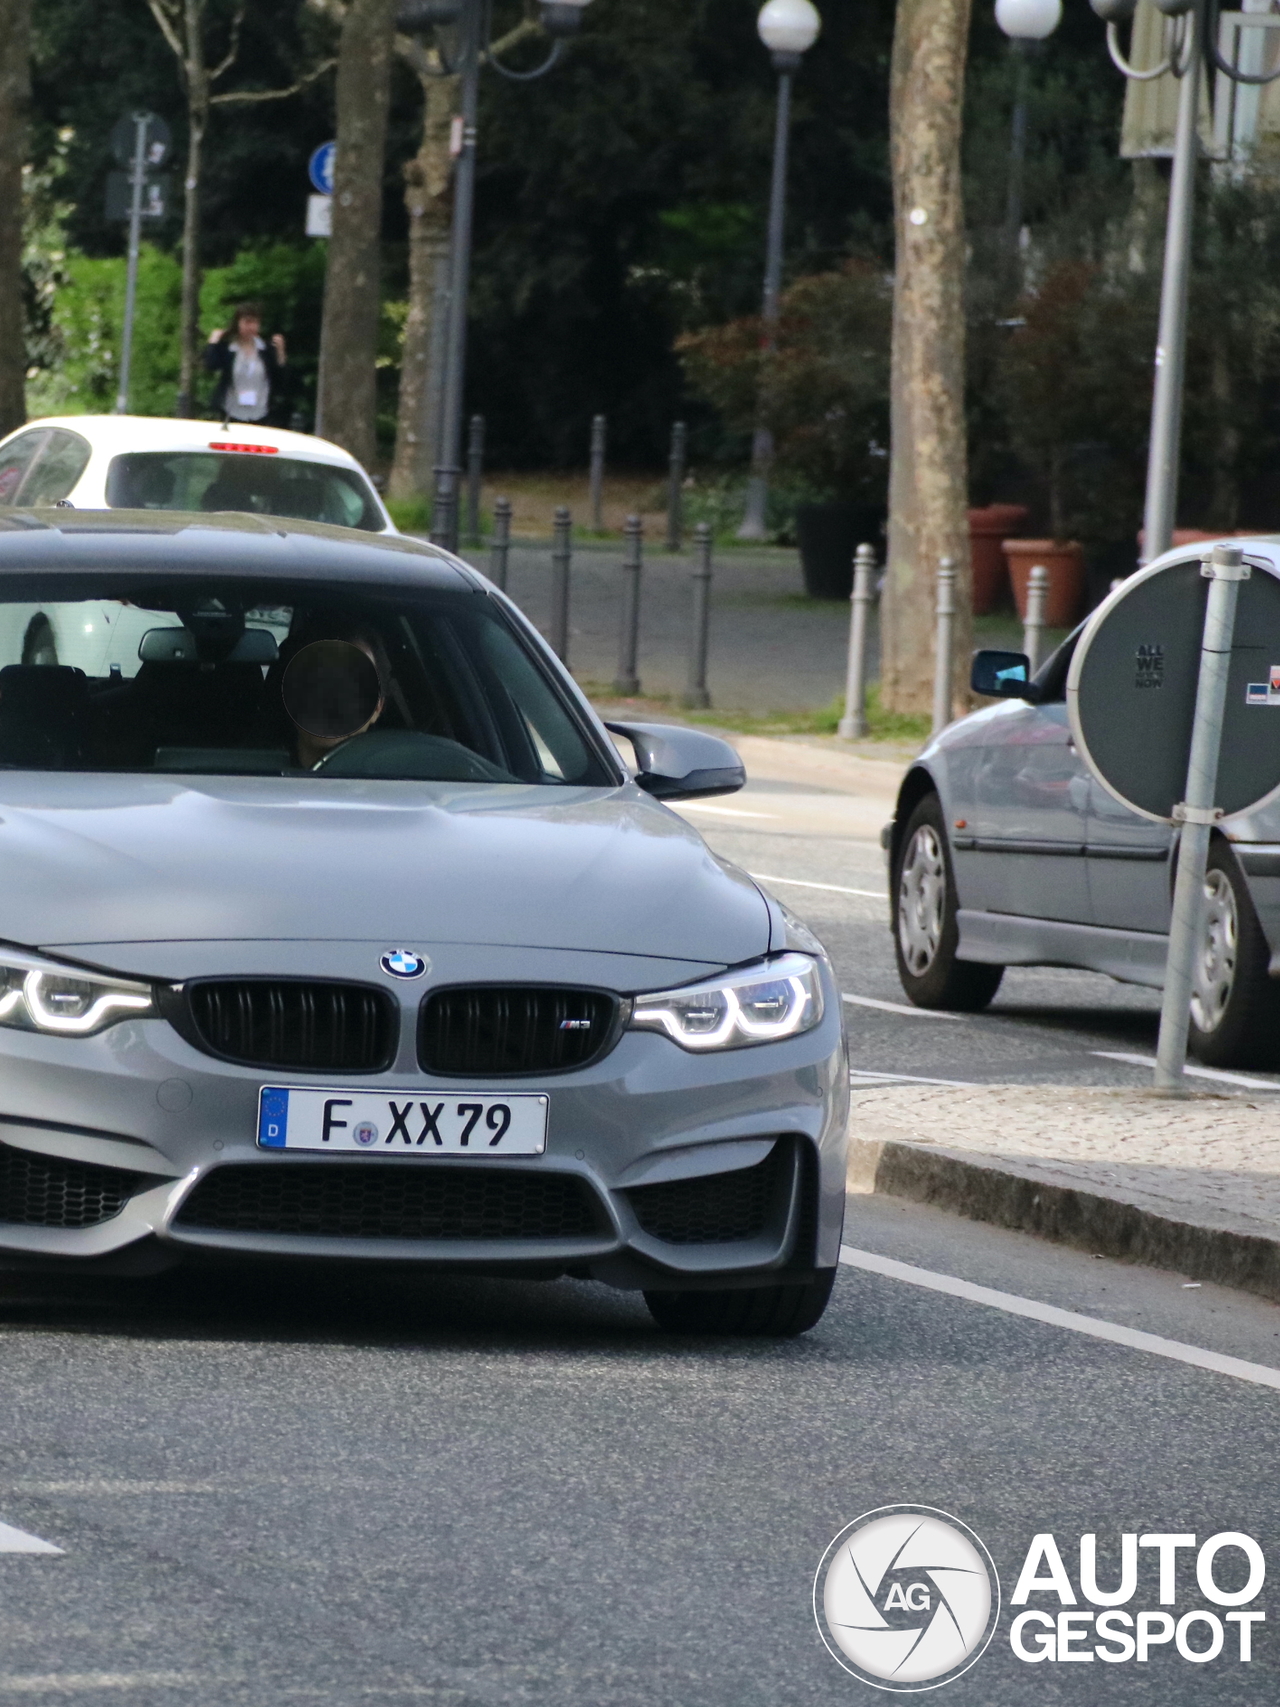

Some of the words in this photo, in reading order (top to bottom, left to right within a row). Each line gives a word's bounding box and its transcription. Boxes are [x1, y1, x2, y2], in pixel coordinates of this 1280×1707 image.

[1138, 645, 1164, 656] ALL
[1137, 657, 1164, 670] WE
[322, 1099, 353, 1141] F
[267, 1124, 279, 1137] D
